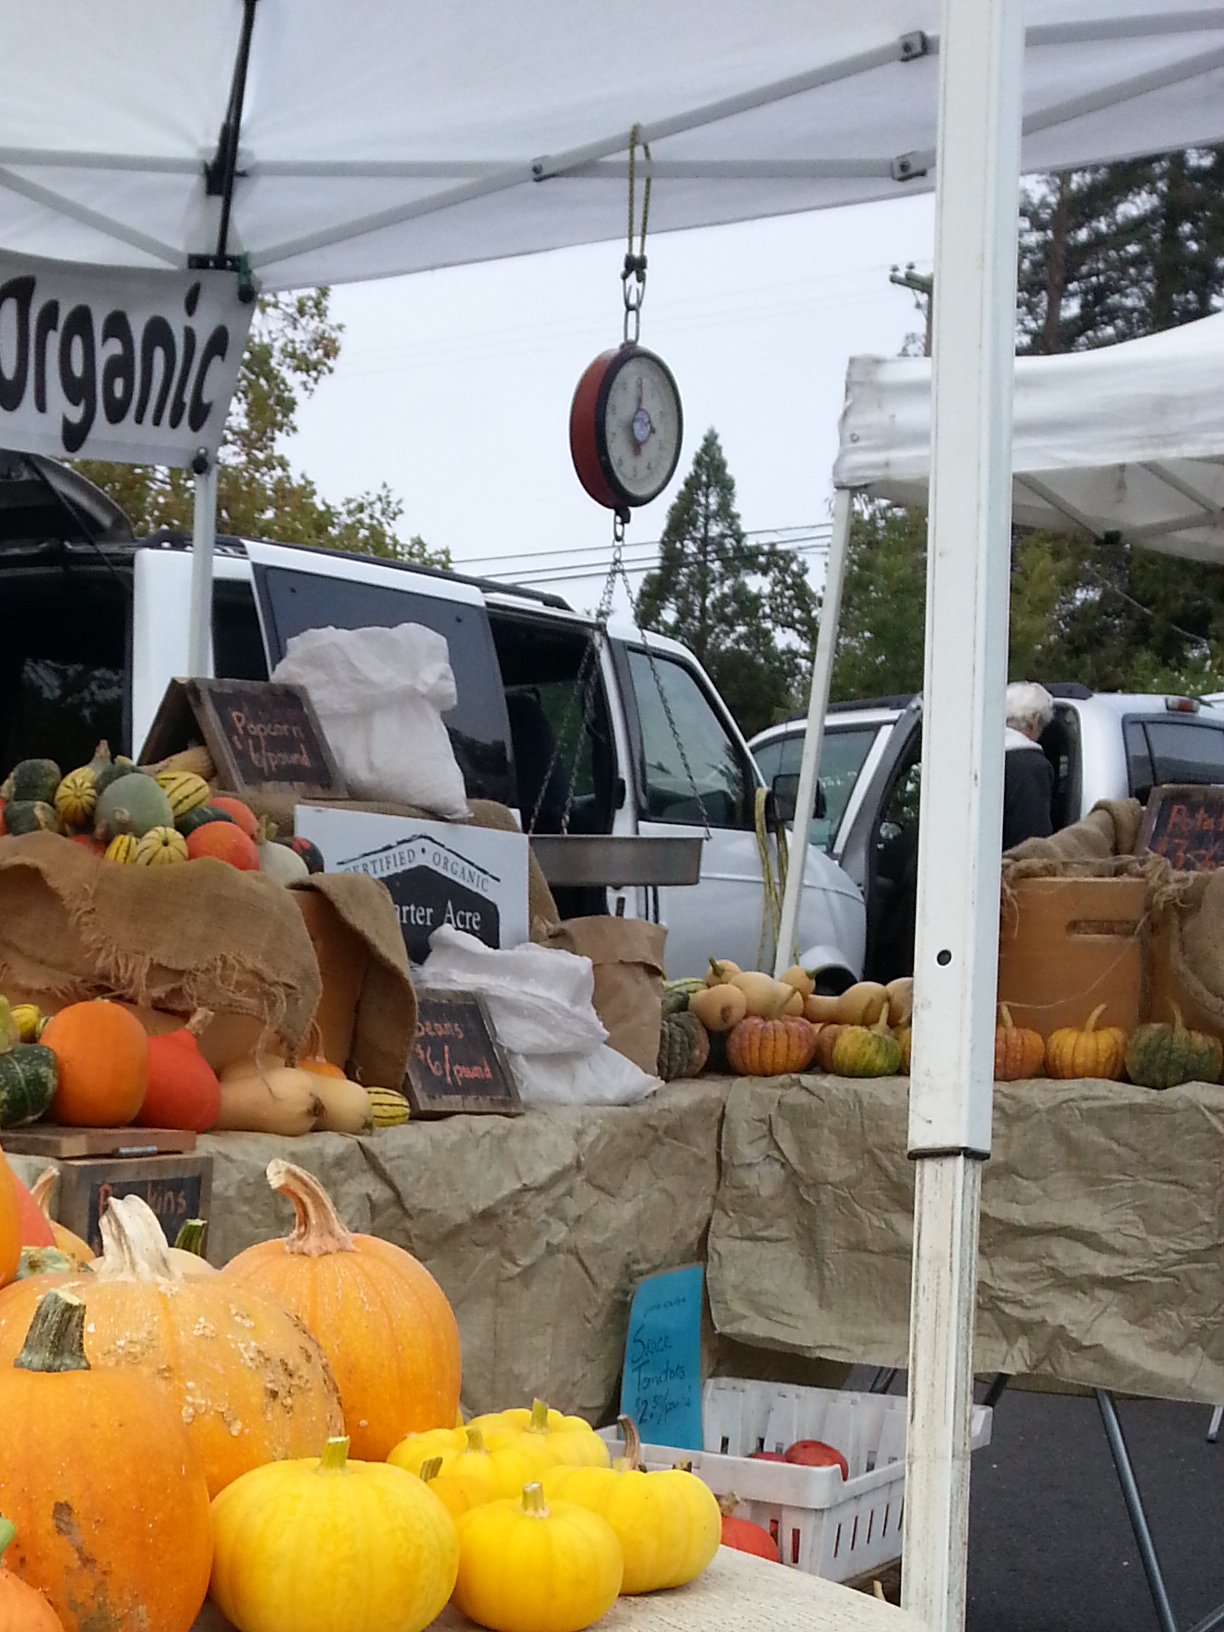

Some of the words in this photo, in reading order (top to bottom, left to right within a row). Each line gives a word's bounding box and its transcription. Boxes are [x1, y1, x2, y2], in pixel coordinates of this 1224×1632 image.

[232, 711, 305, 741] Popcorn
[432, 852, 490, 893] ORGANIC
[444, 899, 482, 930] Acre
